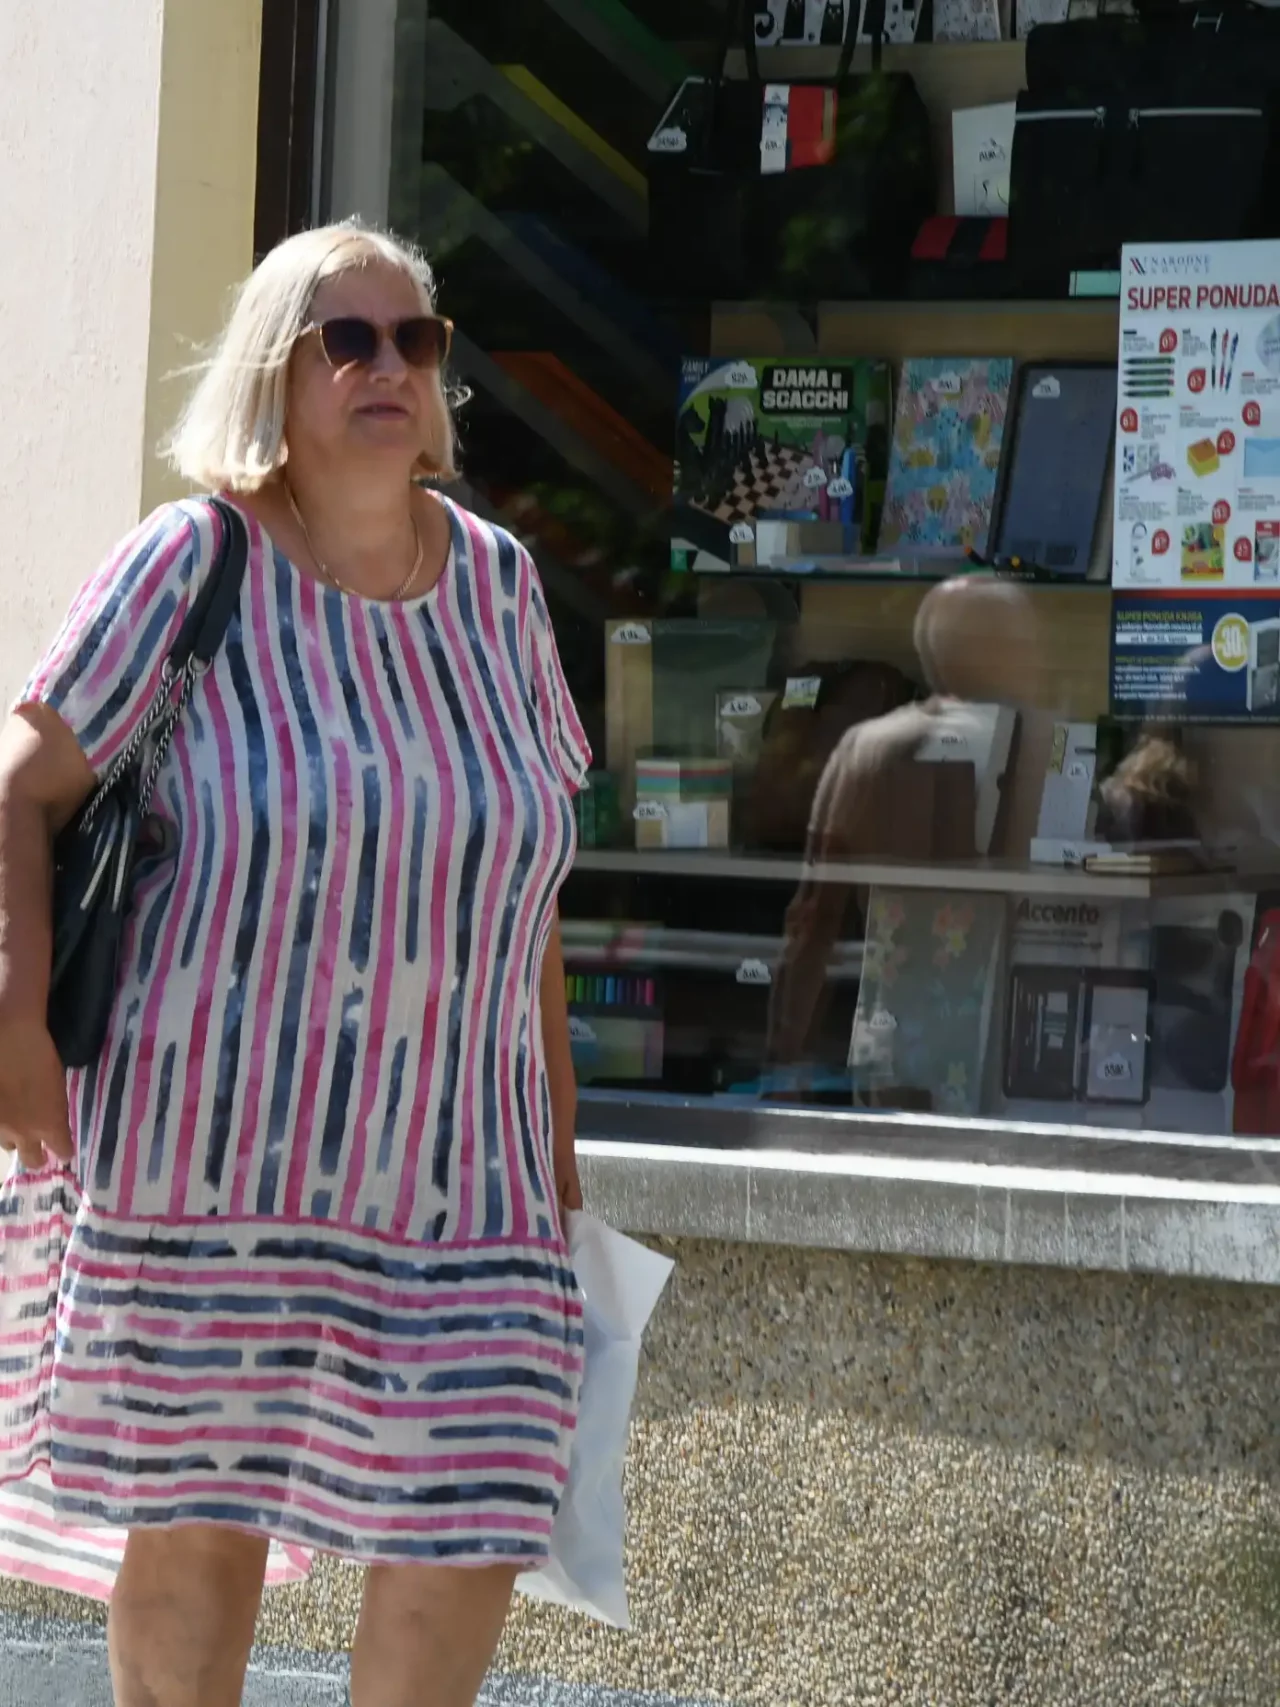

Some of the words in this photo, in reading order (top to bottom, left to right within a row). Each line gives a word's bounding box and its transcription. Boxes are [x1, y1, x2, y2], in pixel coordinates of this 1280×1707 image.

[1128, 286, 1191, 310] SUPER
[1196, 283, 1280, 309] PONUDA
[772, 368, 828, 388] DAMA
[762, 390, 849, 410] SCACCHI
[1016, 897, 1100, 925] Accento
